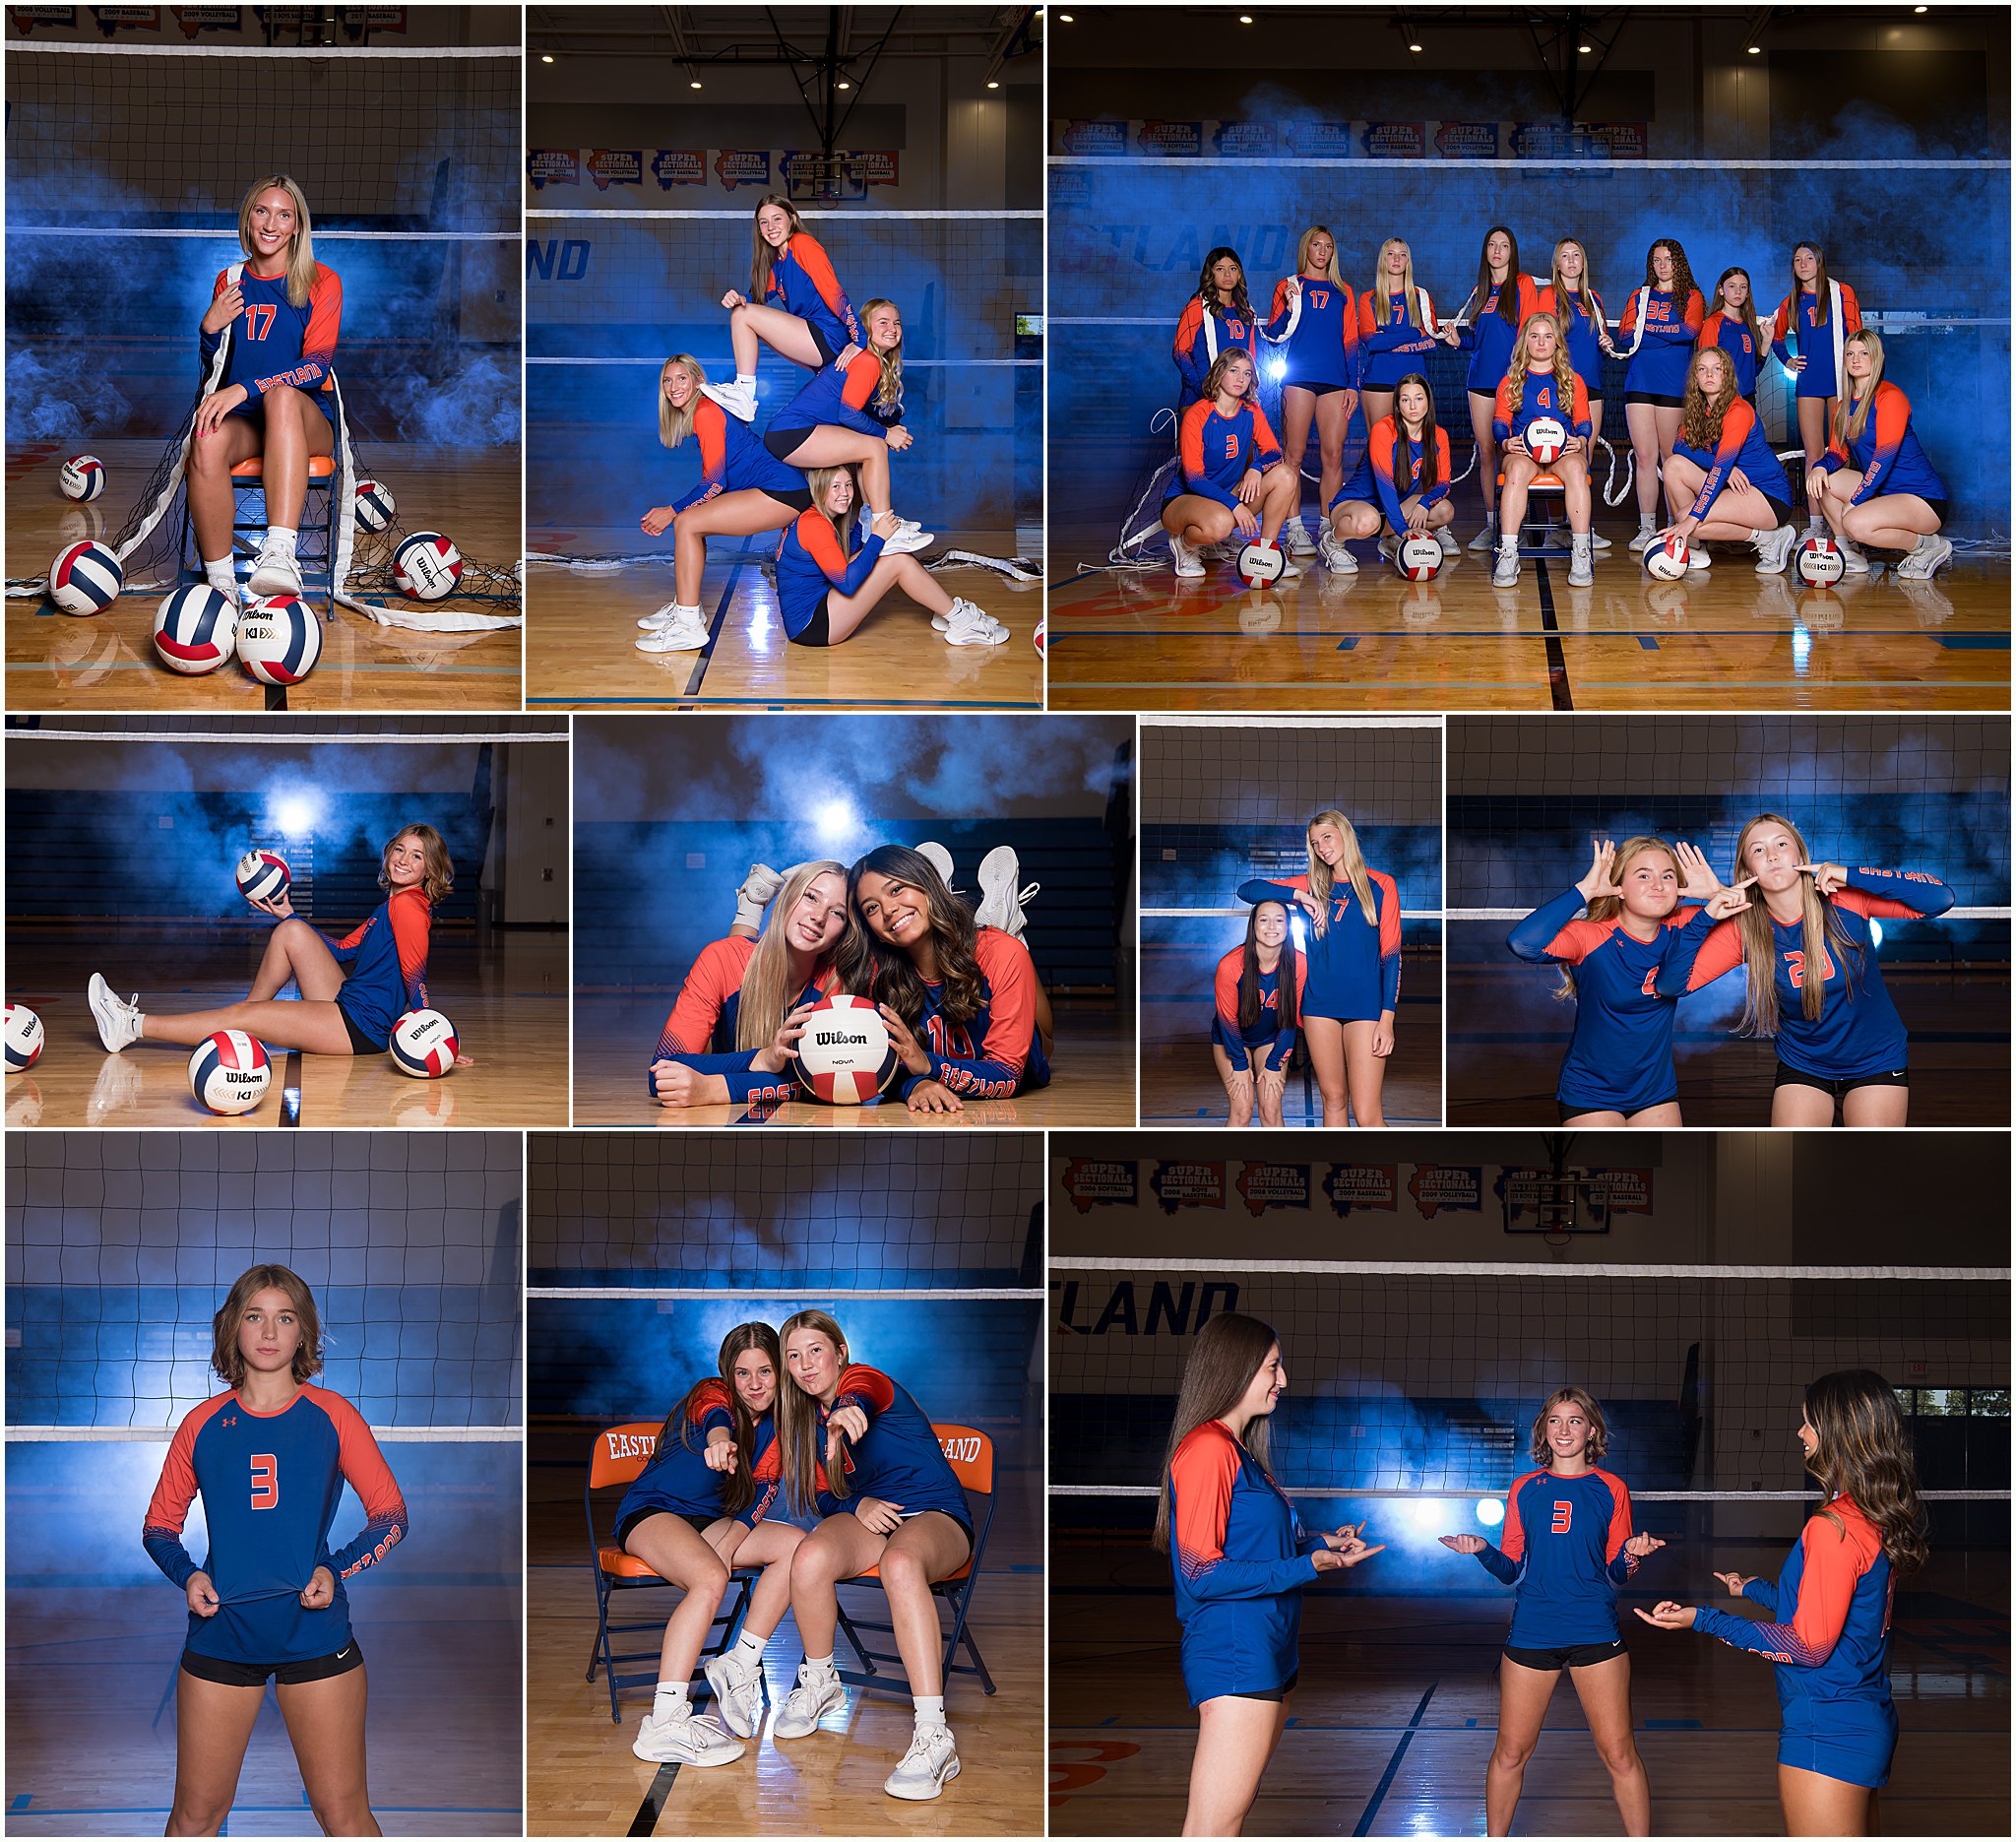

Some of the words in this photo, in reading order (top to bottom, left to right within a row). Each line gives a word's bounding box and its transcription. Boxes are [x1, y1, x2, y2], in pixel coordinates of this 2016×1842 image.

[34, 6, 72, 15] VOLLEYBALL
[122, 9, 151, 18] BASEBALL
[202, 11, 236, 20] VOLLEYBALL
[1072, 132, 1123, 141] SECTIONALS
[1222, 133, 1272, 142] SECTIONALS
[1309, 290, 1330, 309] 17
[1393, 305, 1405, 325] 7
[1647, 300, 1672, 322] 32
[246, 304, 278, 341] 17
[1226, 319, 1245, 340] 10
[1741, 334, 1752, 353] 8
[1538, 387, 1551, 410] 4
[1225, 433, 1239, 460] 3
[1809, 552, 1835, 561] Wilson
[1249, 557, 1273, 568] Wilson
[417, 556, 438, 590] Wilson
[1334, 898, 1350, 922] 7
[410, 1019, 439, 1041] Wilson
[816, 1031, 868, 1047] Wilson
[927, 1015, 976, 1060] 10
[225, 1072, 263, 1084] Wilson
[938, 1062, 1017, 1100] EASTLAND
[236, 1091, 252, 1101] K1
[1080, 1163, 1126, 1174] SUPER
[1167, 1165, 1213, 1175] SUPER
[1254, 1168, 1298, 1177] SUPER
[1340, 1169, 1384, 1178] SUPER
[1073, 1174, 1133, 1183] SECTIONALS
[1161, 1175, 1220, 1185] SECTIONALS
[1426, 1171, 1470, 1180] SUPER
[1247, 1177, 1305, 1187] SECTIONALS
[1333, 1178, 1391, 1188] SECTIONALS
[1419, 1179, 1477, 1190] SECTIONALS
[250, 1453, 280, 1510] 3
[1551, 1499, 1573, 1534] 3
